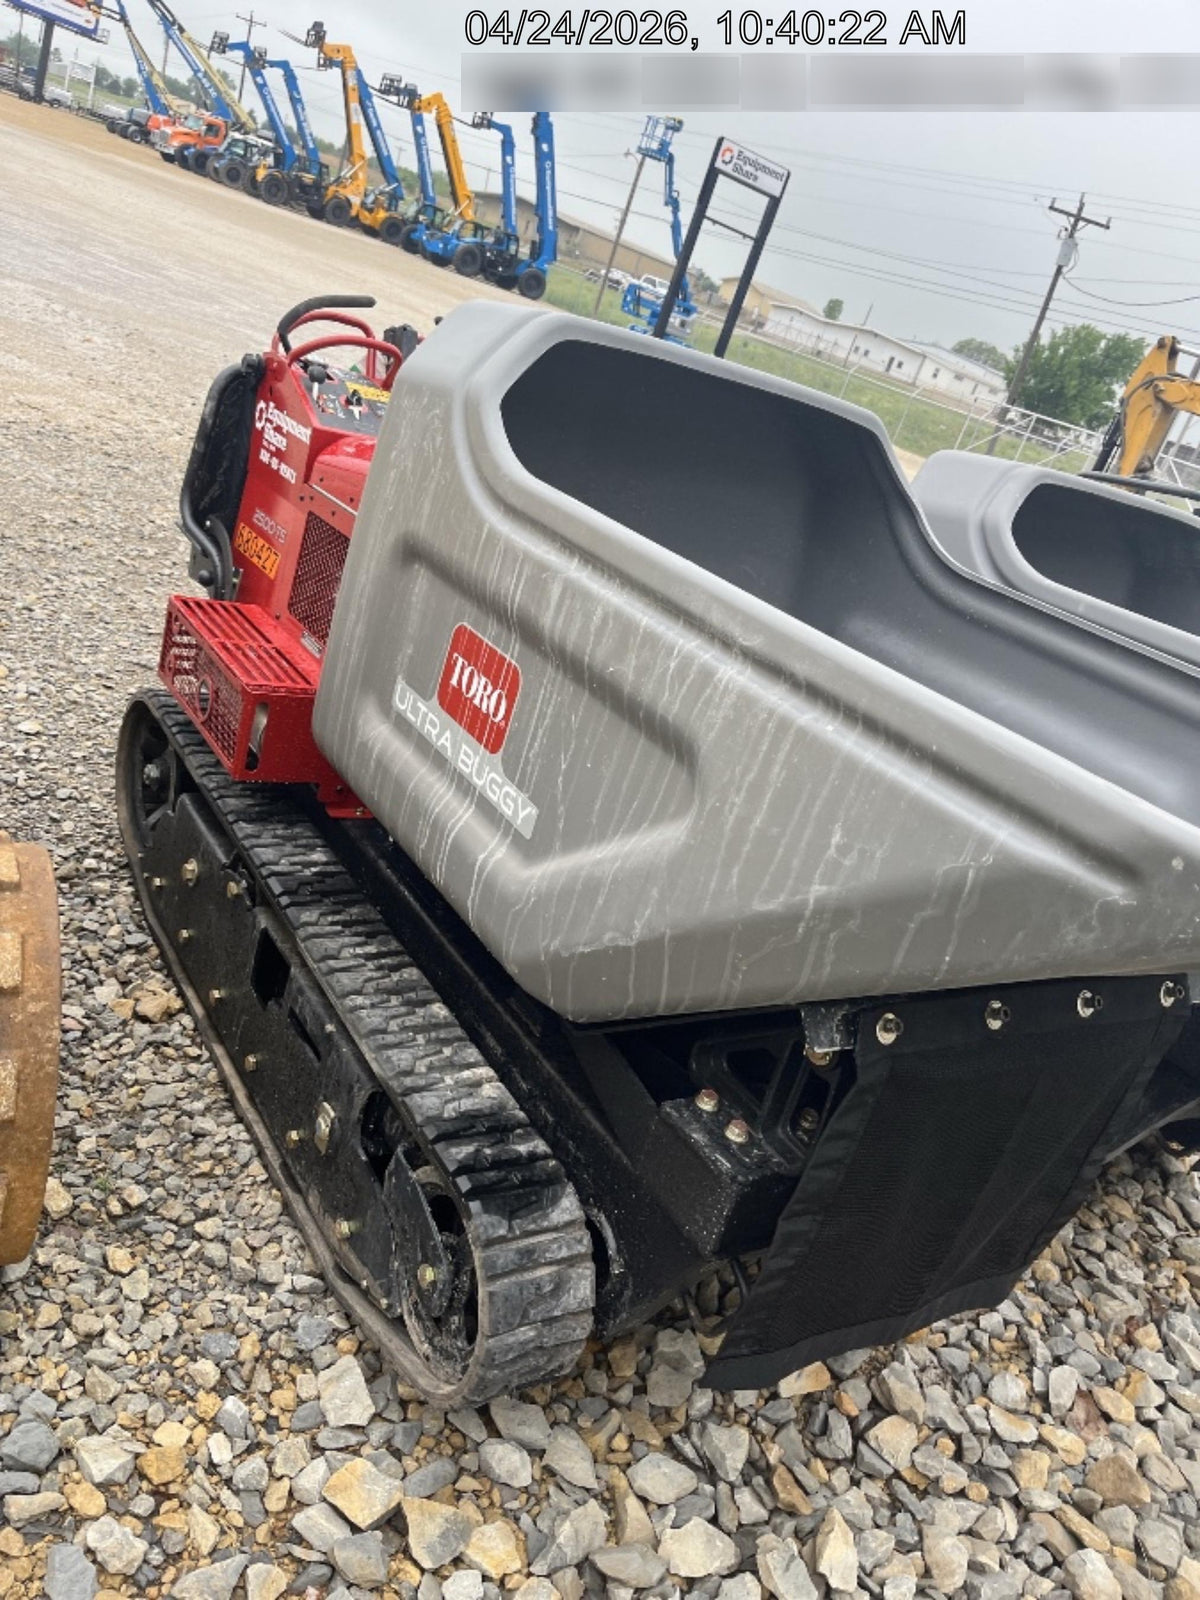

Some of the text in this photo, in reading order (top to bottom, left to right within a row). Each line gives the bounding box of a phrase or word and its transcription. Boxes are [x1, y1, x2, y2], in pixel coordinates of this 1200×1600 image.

[732, 162, 758, 182] Share
[736, 149, 785, 182] Equipment
[449, 652, 507, 725] TORO
[395, 685, 533, 825] ULTRA BUGGY
